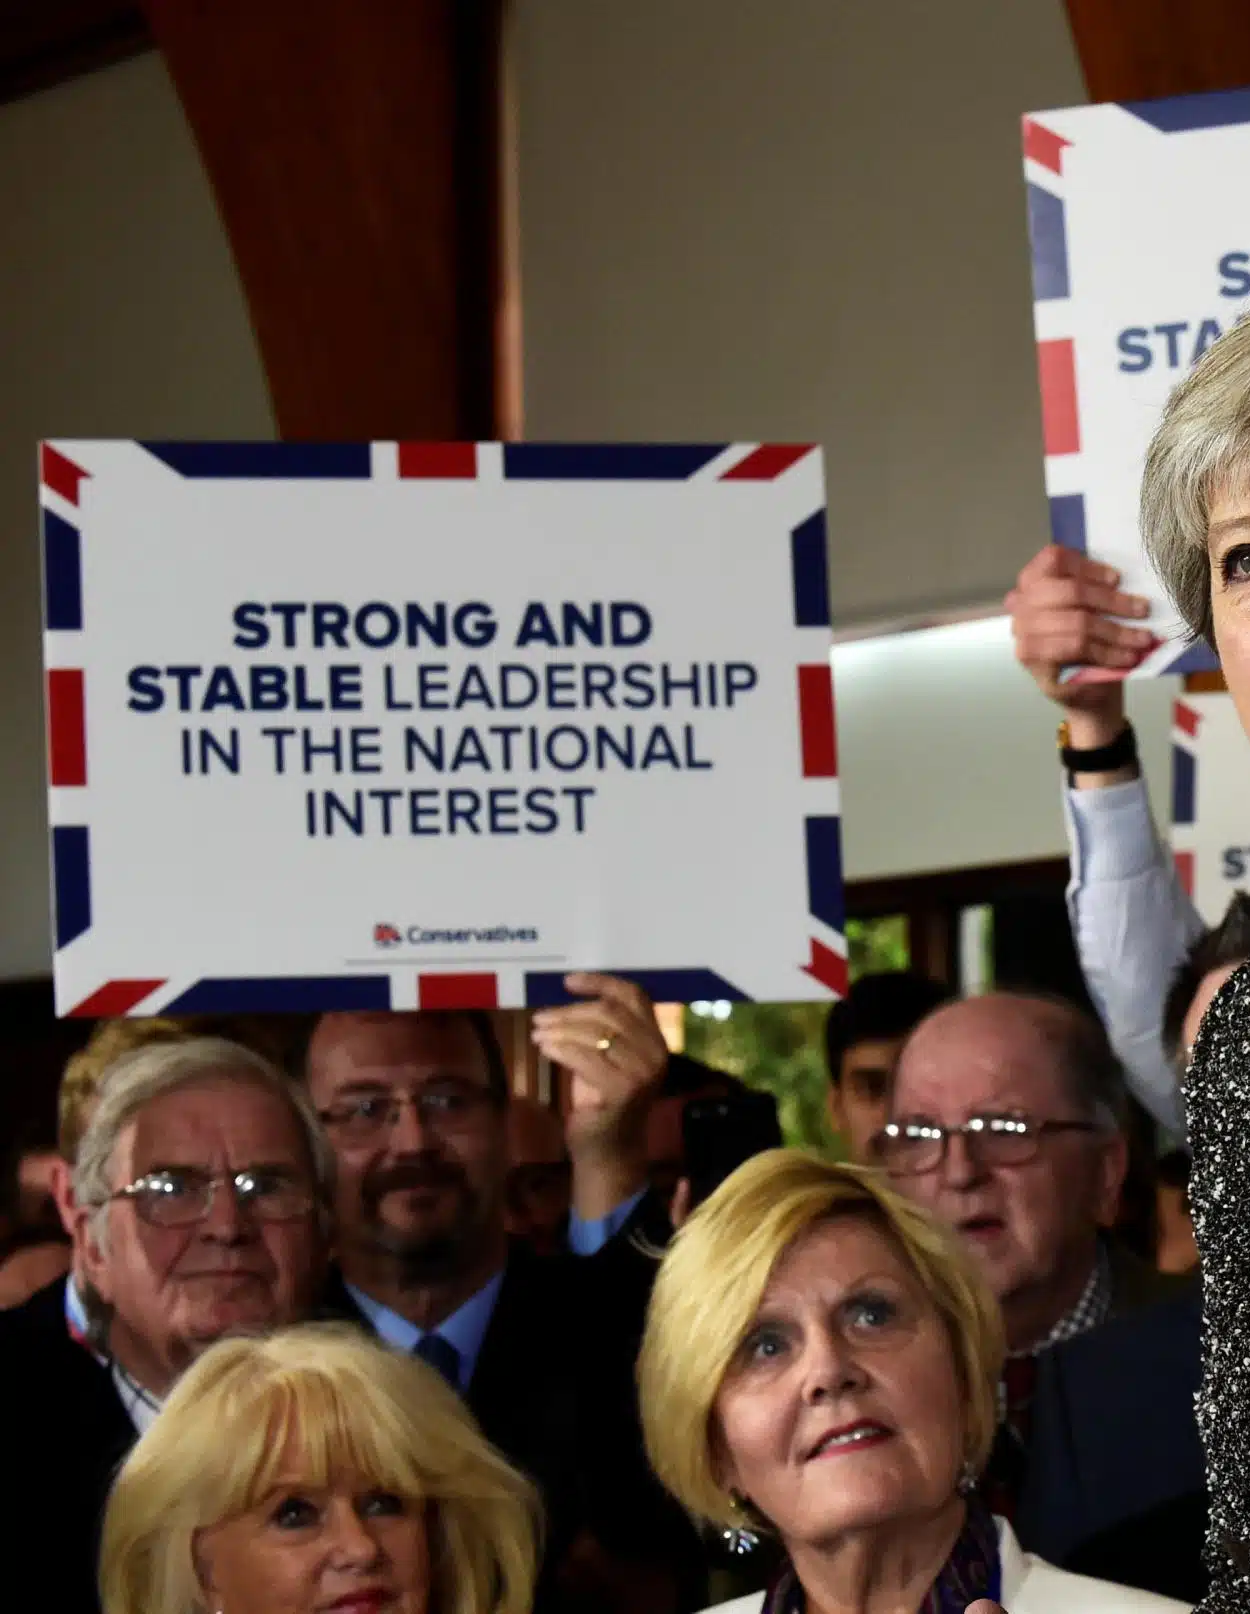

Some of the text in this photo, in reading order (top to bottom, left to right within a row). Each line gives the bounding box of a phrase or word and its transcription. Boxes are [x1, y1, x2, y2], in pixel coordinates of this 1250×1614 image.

[1116, 317, 1222, 373] STA
[231, 601, 654, 650] STRONG AND
[125, 662, 760, 713] STABLE LEADERSHIP
[181, 722, 714, 775] IN THE NATIONAL
[305, 787, 597, 837] INTEREST
[406, 924, 540, 945] Conservatives
